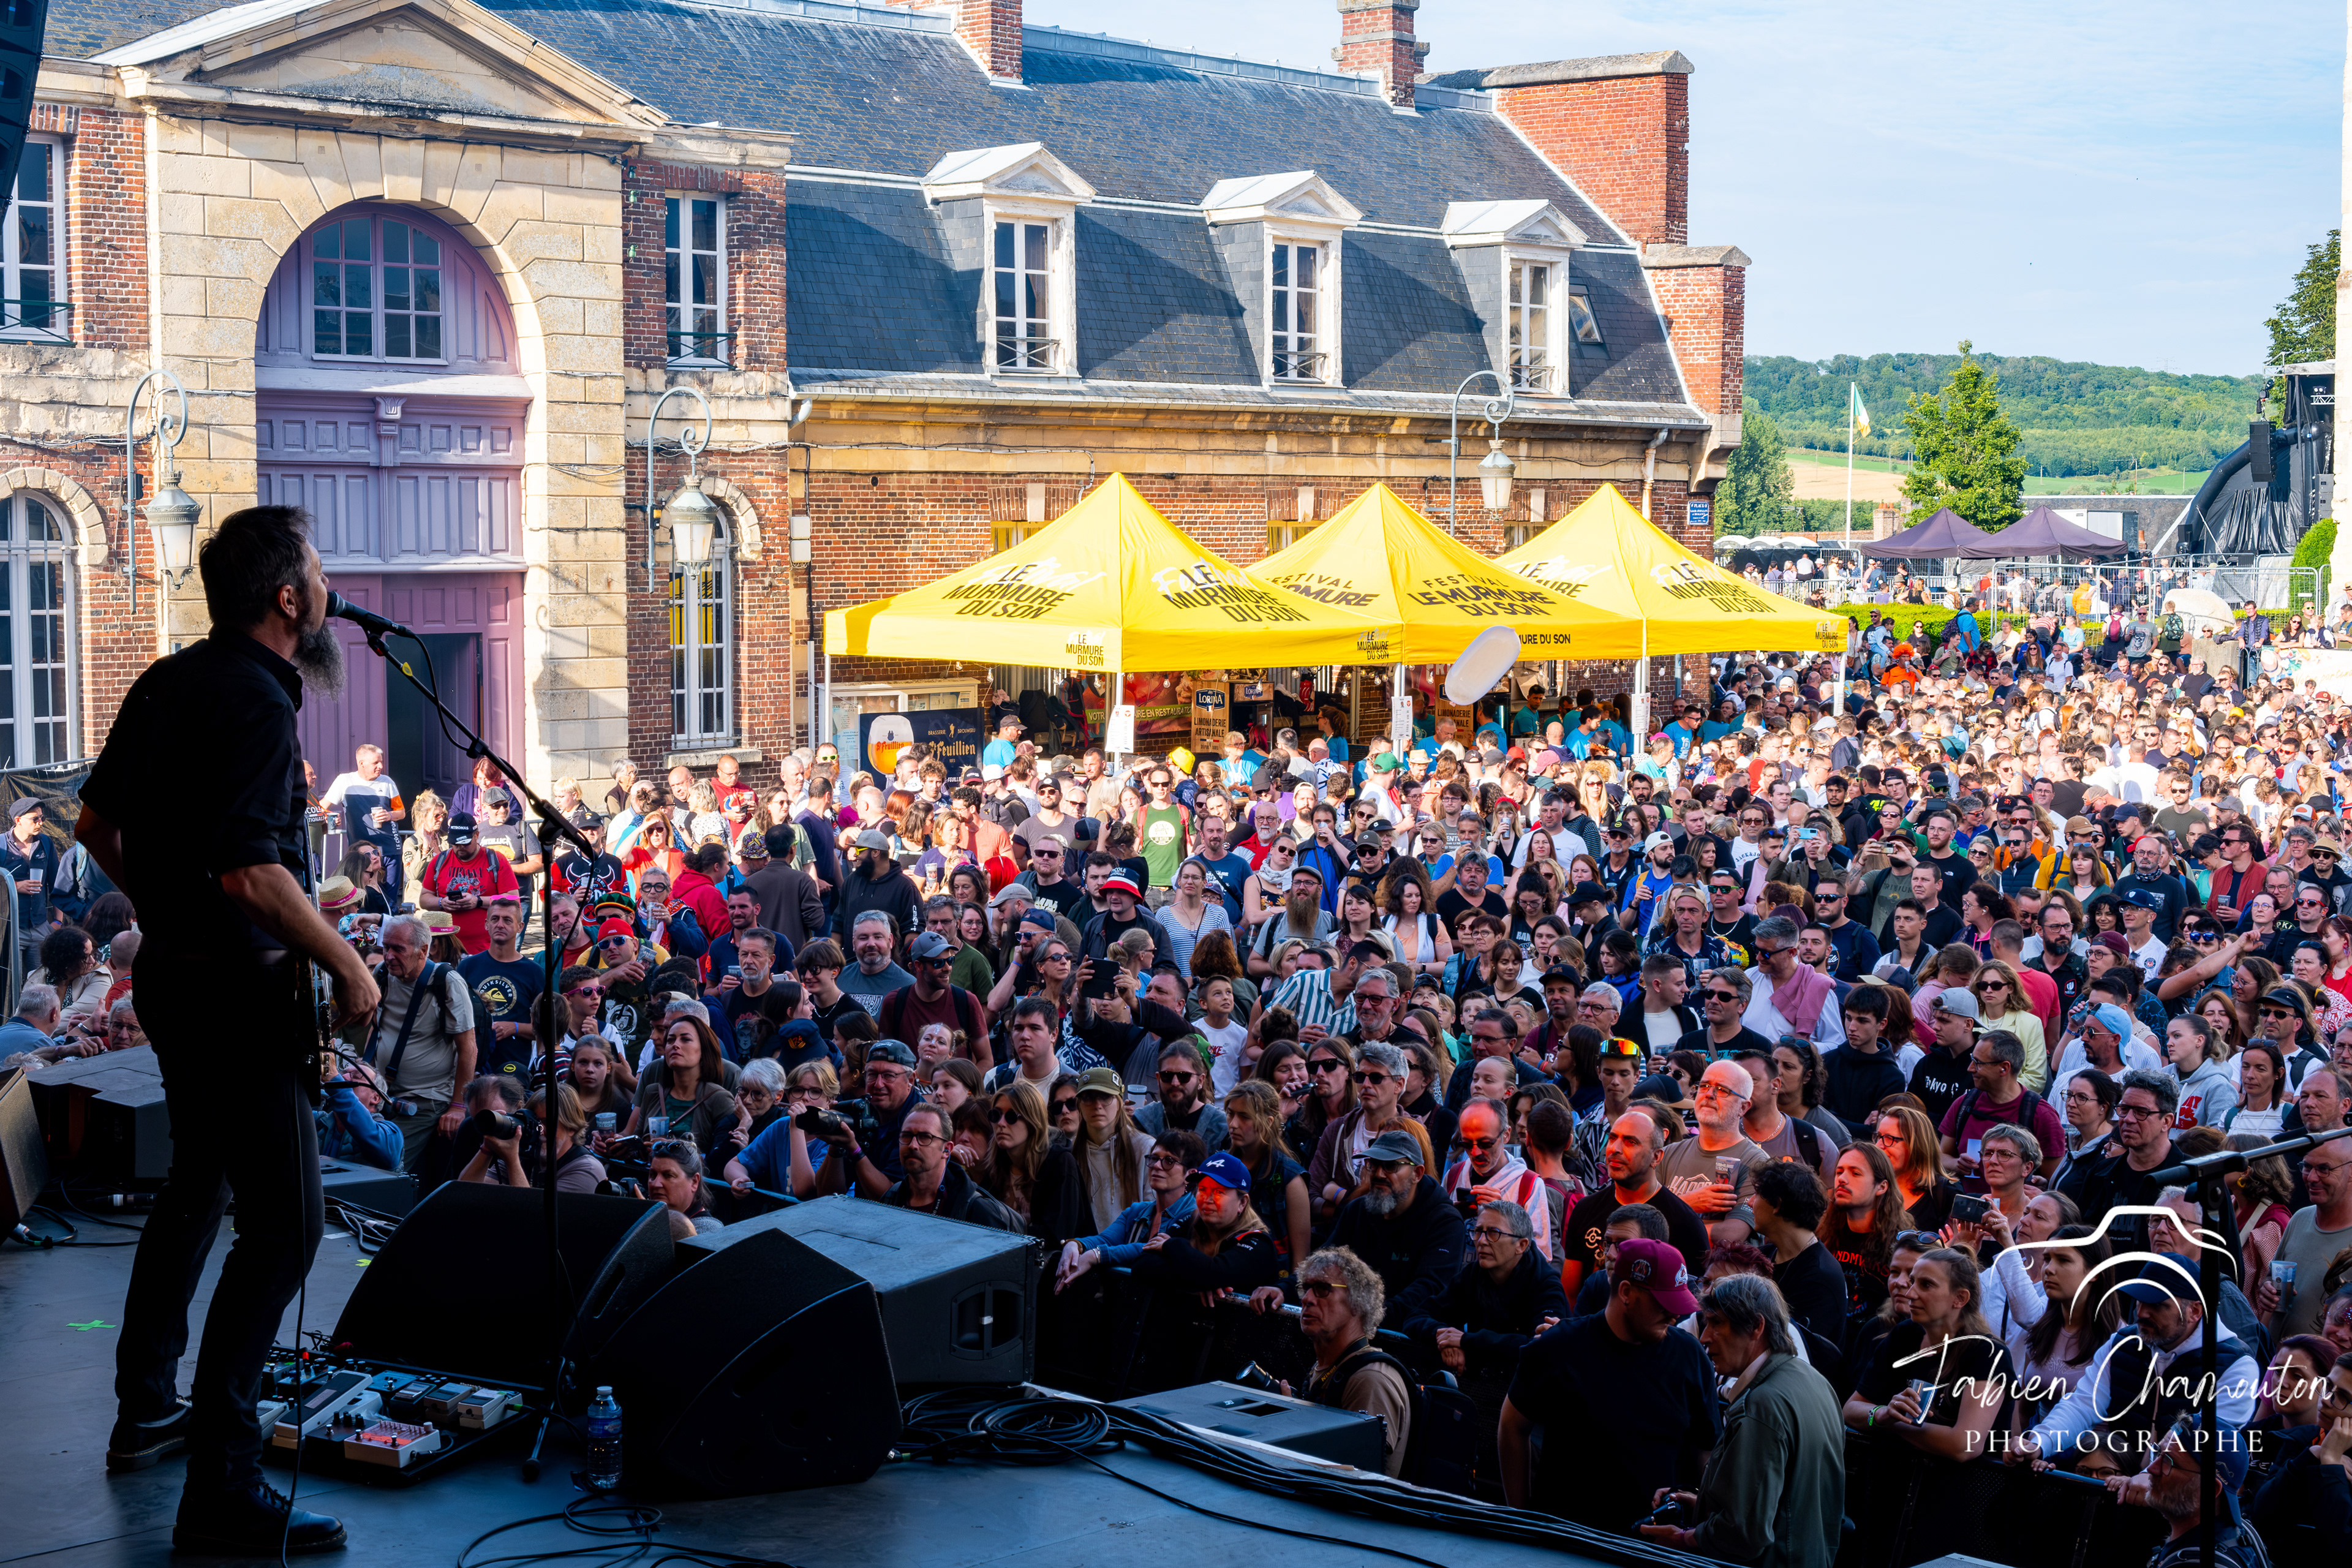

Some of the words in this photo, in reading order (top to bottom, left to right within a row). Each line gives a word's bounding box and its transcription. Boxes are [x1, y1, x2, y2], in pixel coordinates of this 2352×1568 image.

[998, 564, 1038, 582] LE
[1180, 565, 1220, 587] LE
[1670, 563, 1704, 581] LE
[1422, 574, 1509, 589] FESTIVAL
[941, 582, 1075, 607] MURMURE
[1406, 592, 1447, 606] LE
[1434, 585, 1558, 605] MURMURE
[1662, 581, 1757, 600] MURMURE
[1162, 585, 1289, 609] MURMURE
[955, 600, 1001, 616] DU
[991, 603, 1053, 619] SON
[1455, 603, 1499, 616] DU
[1493, 601, 1553, 616] SON
[1708, 598, 1743, 612] DU
[1733, 597, 1778, 613] SON
[1220, 605, 1263, 622] DU
[1255, 605, 1311, 622] SON
[1822, 623, 1828, 632] LE
[1078, 634, 1087, 644] LE
[1367, 631, 1375, 642] LE
[1539, 634, 1552, 645] DU
[1553, 633, 1571, 644] SON
[1815, 631, 1838, 640] MURMURE
[1066, 644, 1104, 656] MURMURE
[1357, 641, 1389, 651] MURMURE
[1822, 640, 1829, 649] DU
[1829, 640, 1838, 649] SON
[1077, 655, 1088, 665] DU
[1088, 655, 1104, 666] SON
[1367, 650, 1376, 660] DU
[1376, 650, 1389, 660] SON
[1199, 693, 1223, 704] LORINA
[1147, 709, 1155, 718] EN
[1437, 709, 1471, 718] LIMONADERIE
[1194, 717, 1227, 728] LIMONADERIE
[1195, 727, 1225, 737] ARTISANALE
[937, 740, 976, 761] Feuillien
[448, 867, 483, 878] NIRVANA
